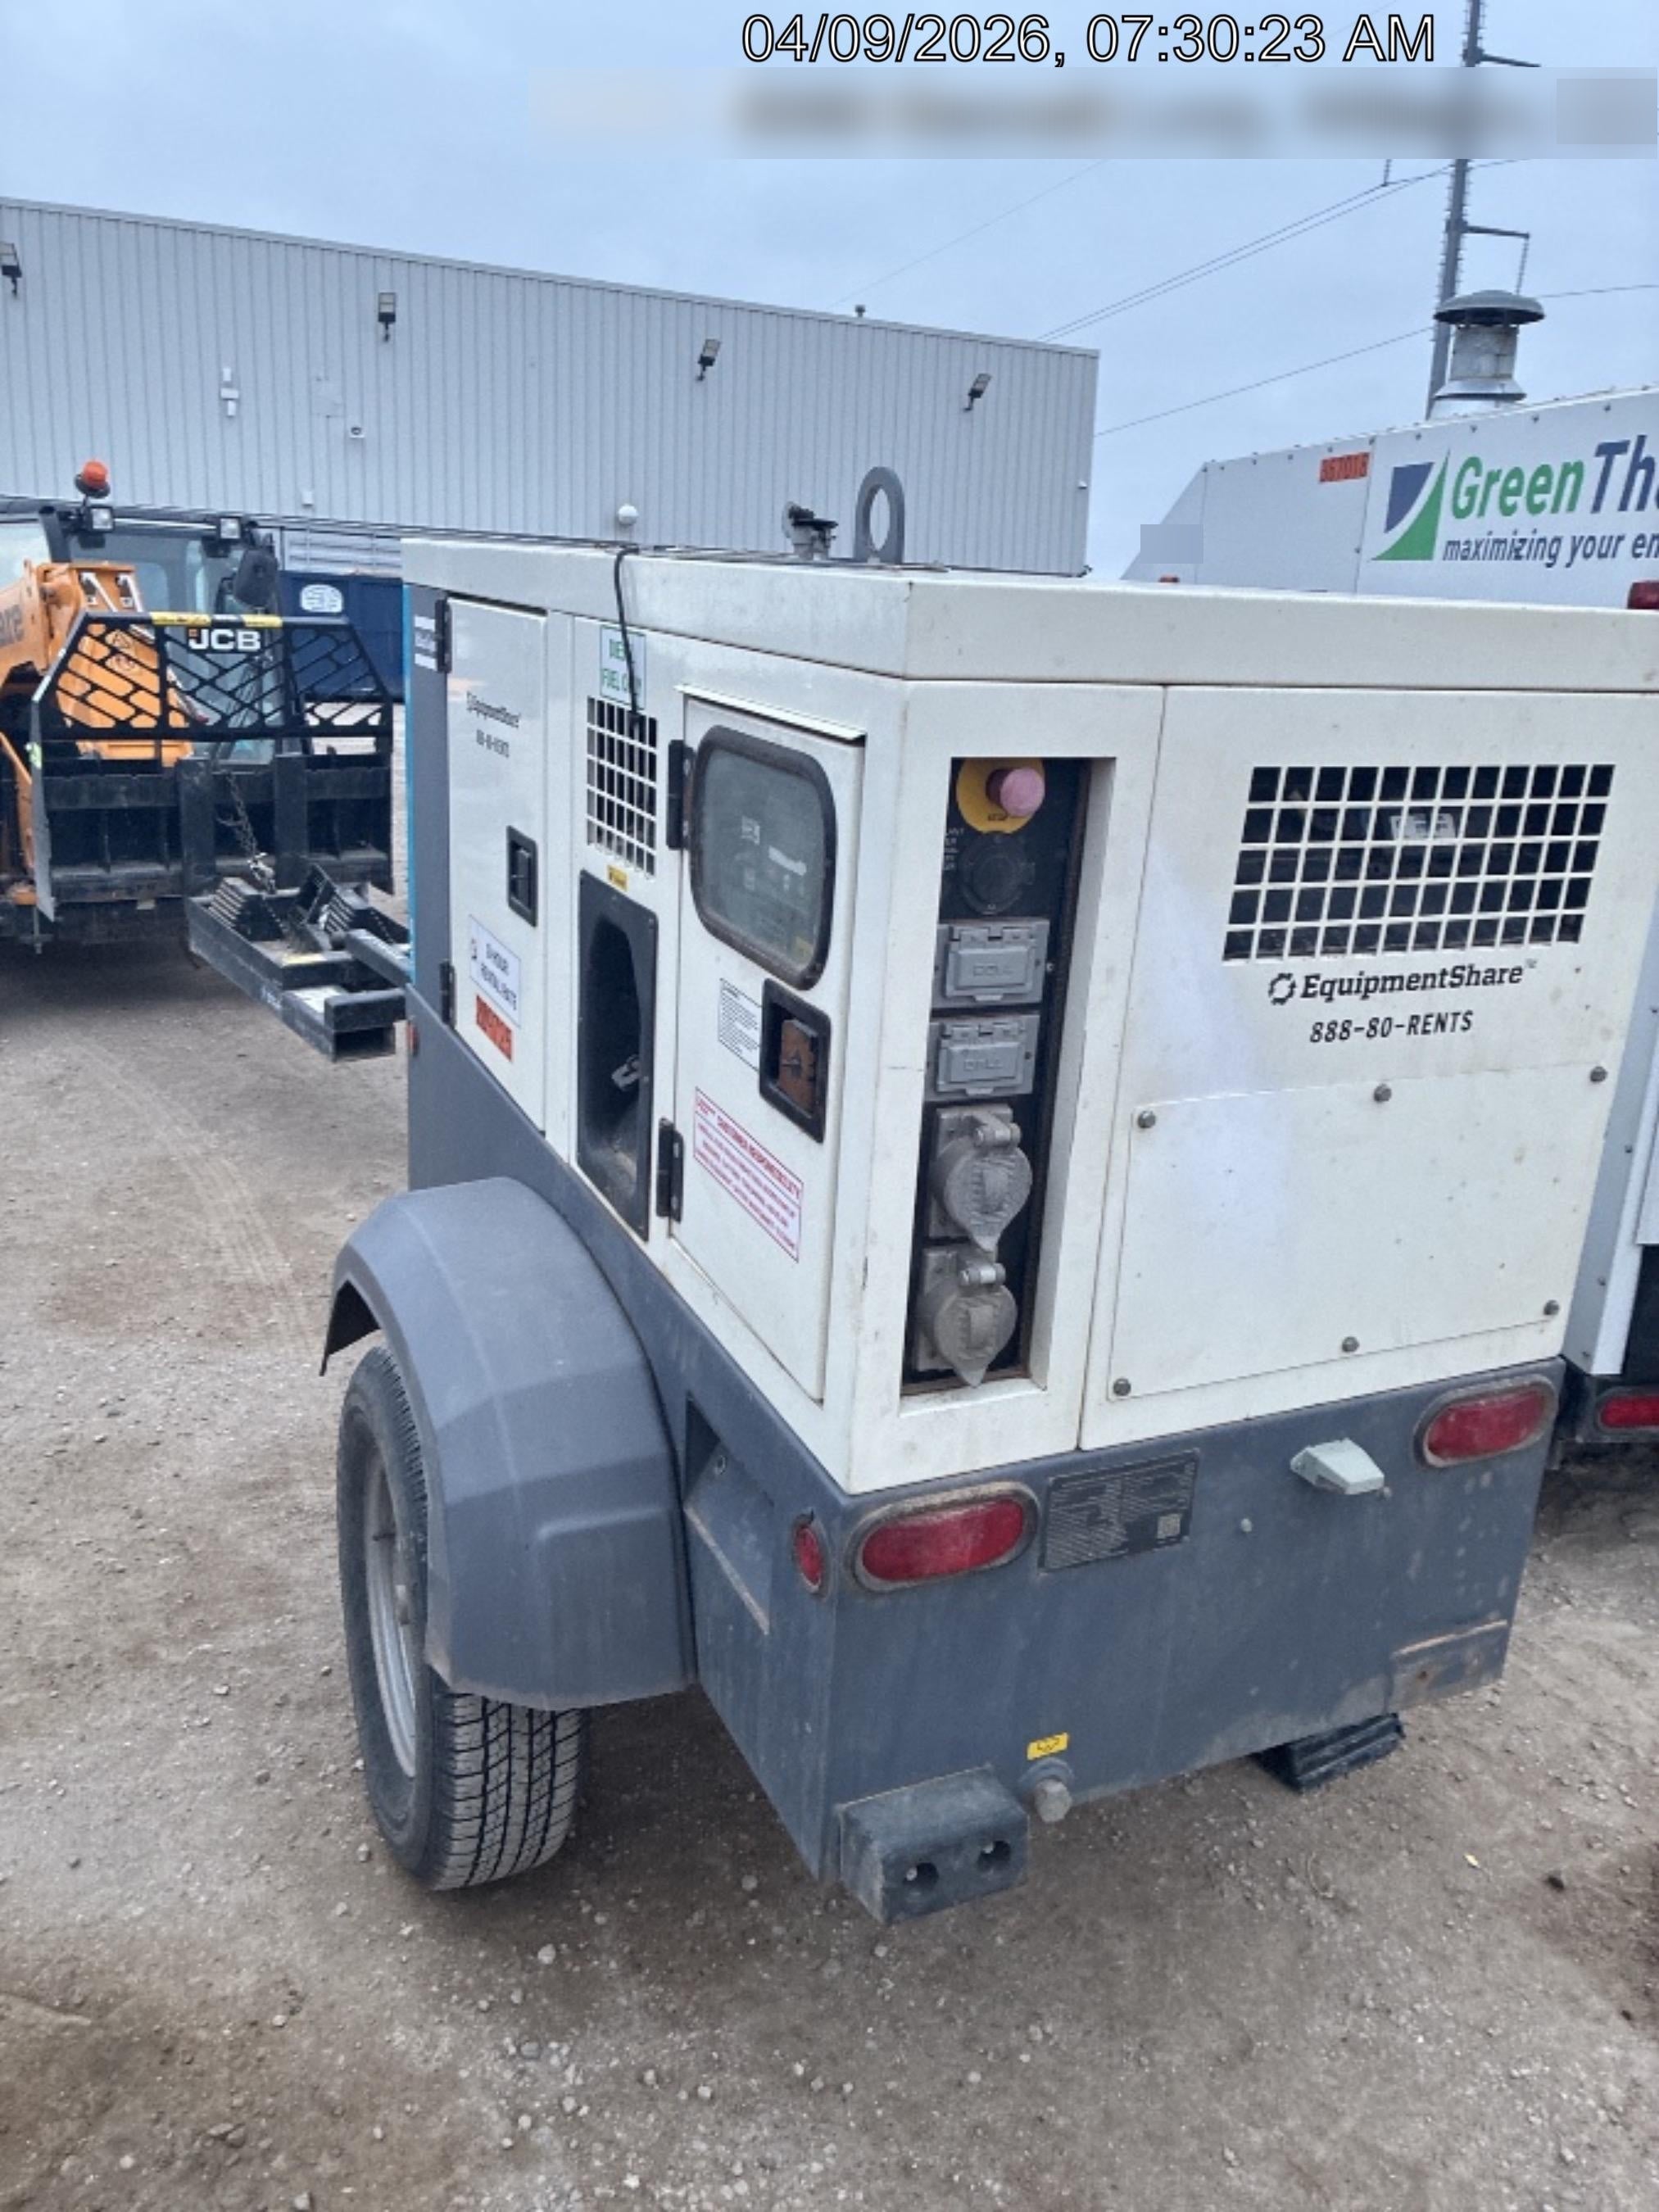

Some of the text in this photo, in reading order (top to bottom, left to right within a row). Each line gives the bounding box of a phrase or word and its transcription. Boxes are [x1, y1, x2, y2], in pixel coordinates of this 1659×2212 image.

[1452, 434, 1659, 519] GreenTh
[1443, 528, 1563, 568] maximizing
[1565, 534, 1625, 568] your
[188, 628, 261, 651] JCB
[1300, 964, 1523, 1004] EquipmentShare
[1310, 1010, 1473, 1042] 888-80-RENTS
